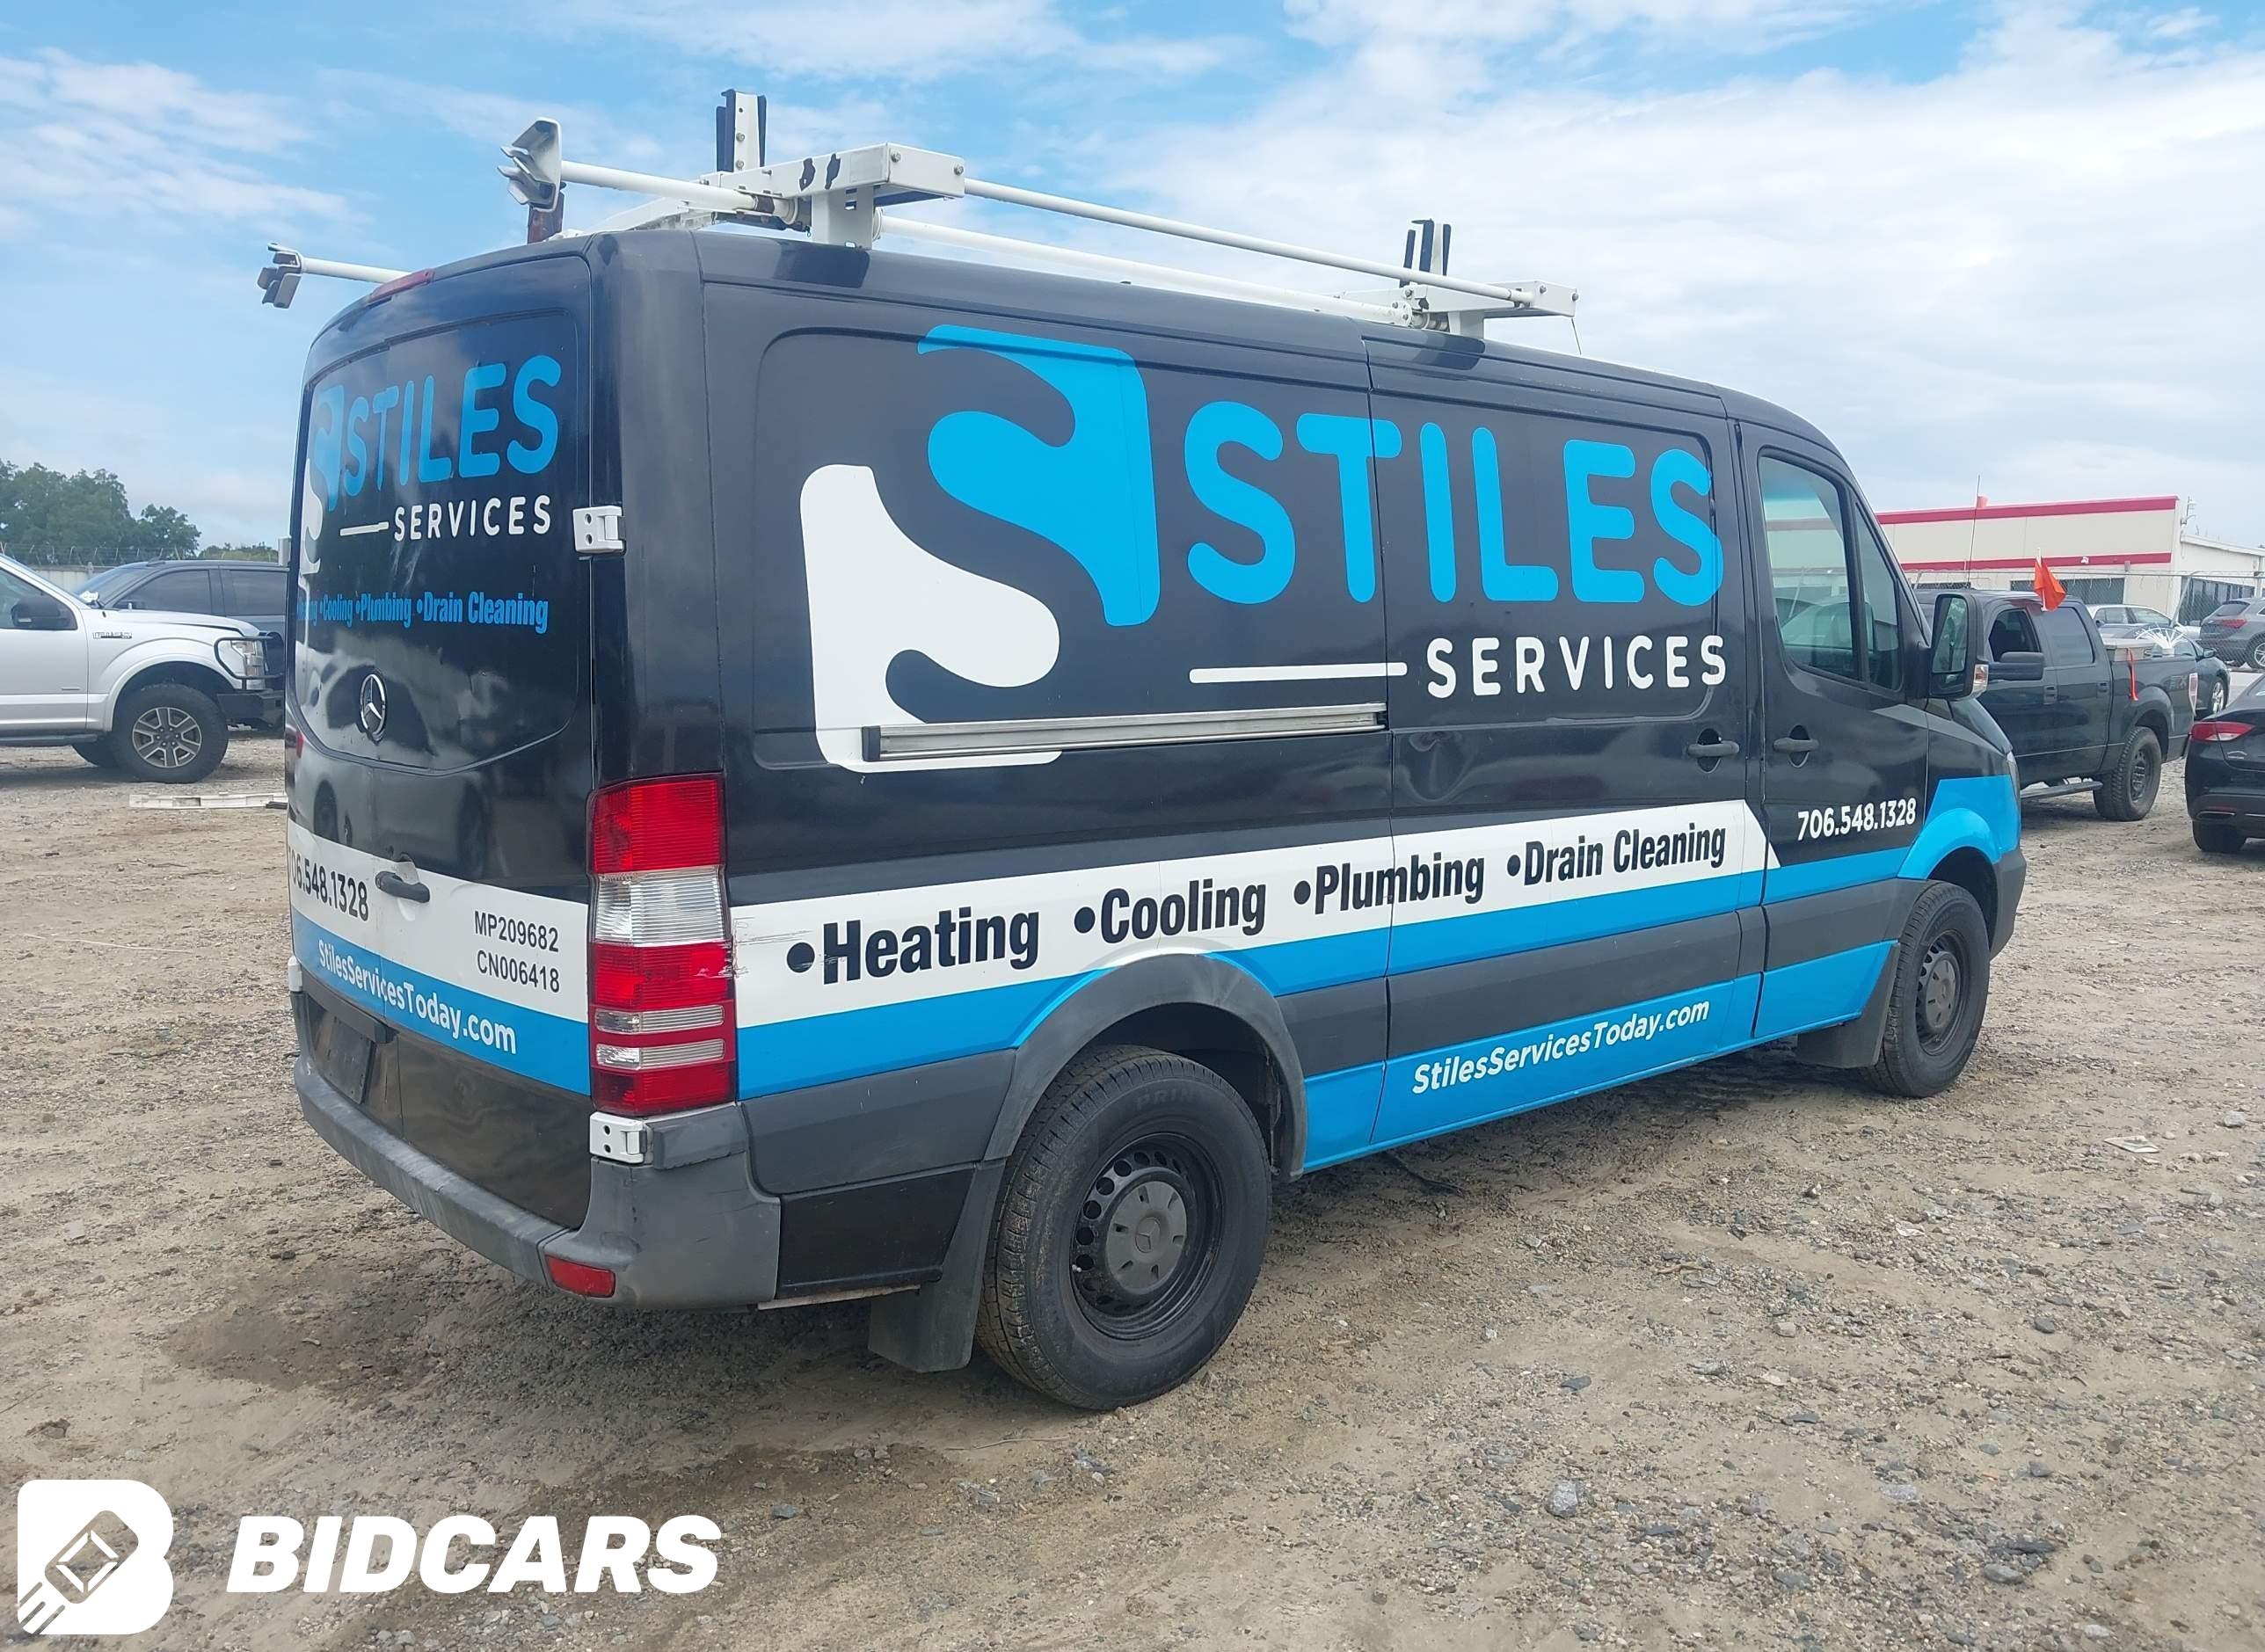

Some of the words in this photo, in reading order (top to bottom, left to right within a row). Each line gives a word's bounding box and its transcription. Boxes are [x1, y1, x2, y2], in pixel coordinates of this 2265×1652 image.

[343, 354, 562, 497] STILES
[393, 494, 551, 542] SERVICES
[1184, 401, 1723, 607] STILES
[468, 591, 550, 634] Cleaning
[1426, 635, 1727, 699] SERVICES
[1797, 797, 1917, 841] 706.548.1328
[474, 910, 560, 953] MP209682
[823, 906, 1040, 985] Heating
[1101, 877, 1267, 944] Cooling
[1315, 851, 1485, 915] Plumbing
[1523, 834, 1603, 886] Drain
[1613, 822, 1727, 874] Cleaning
[317, 939, 517, 1055] StilesServicesToday.com
[477, 950, 561, 993] CN006418
[1411, 999, 1710, 1094] StilesServicesToday.com
